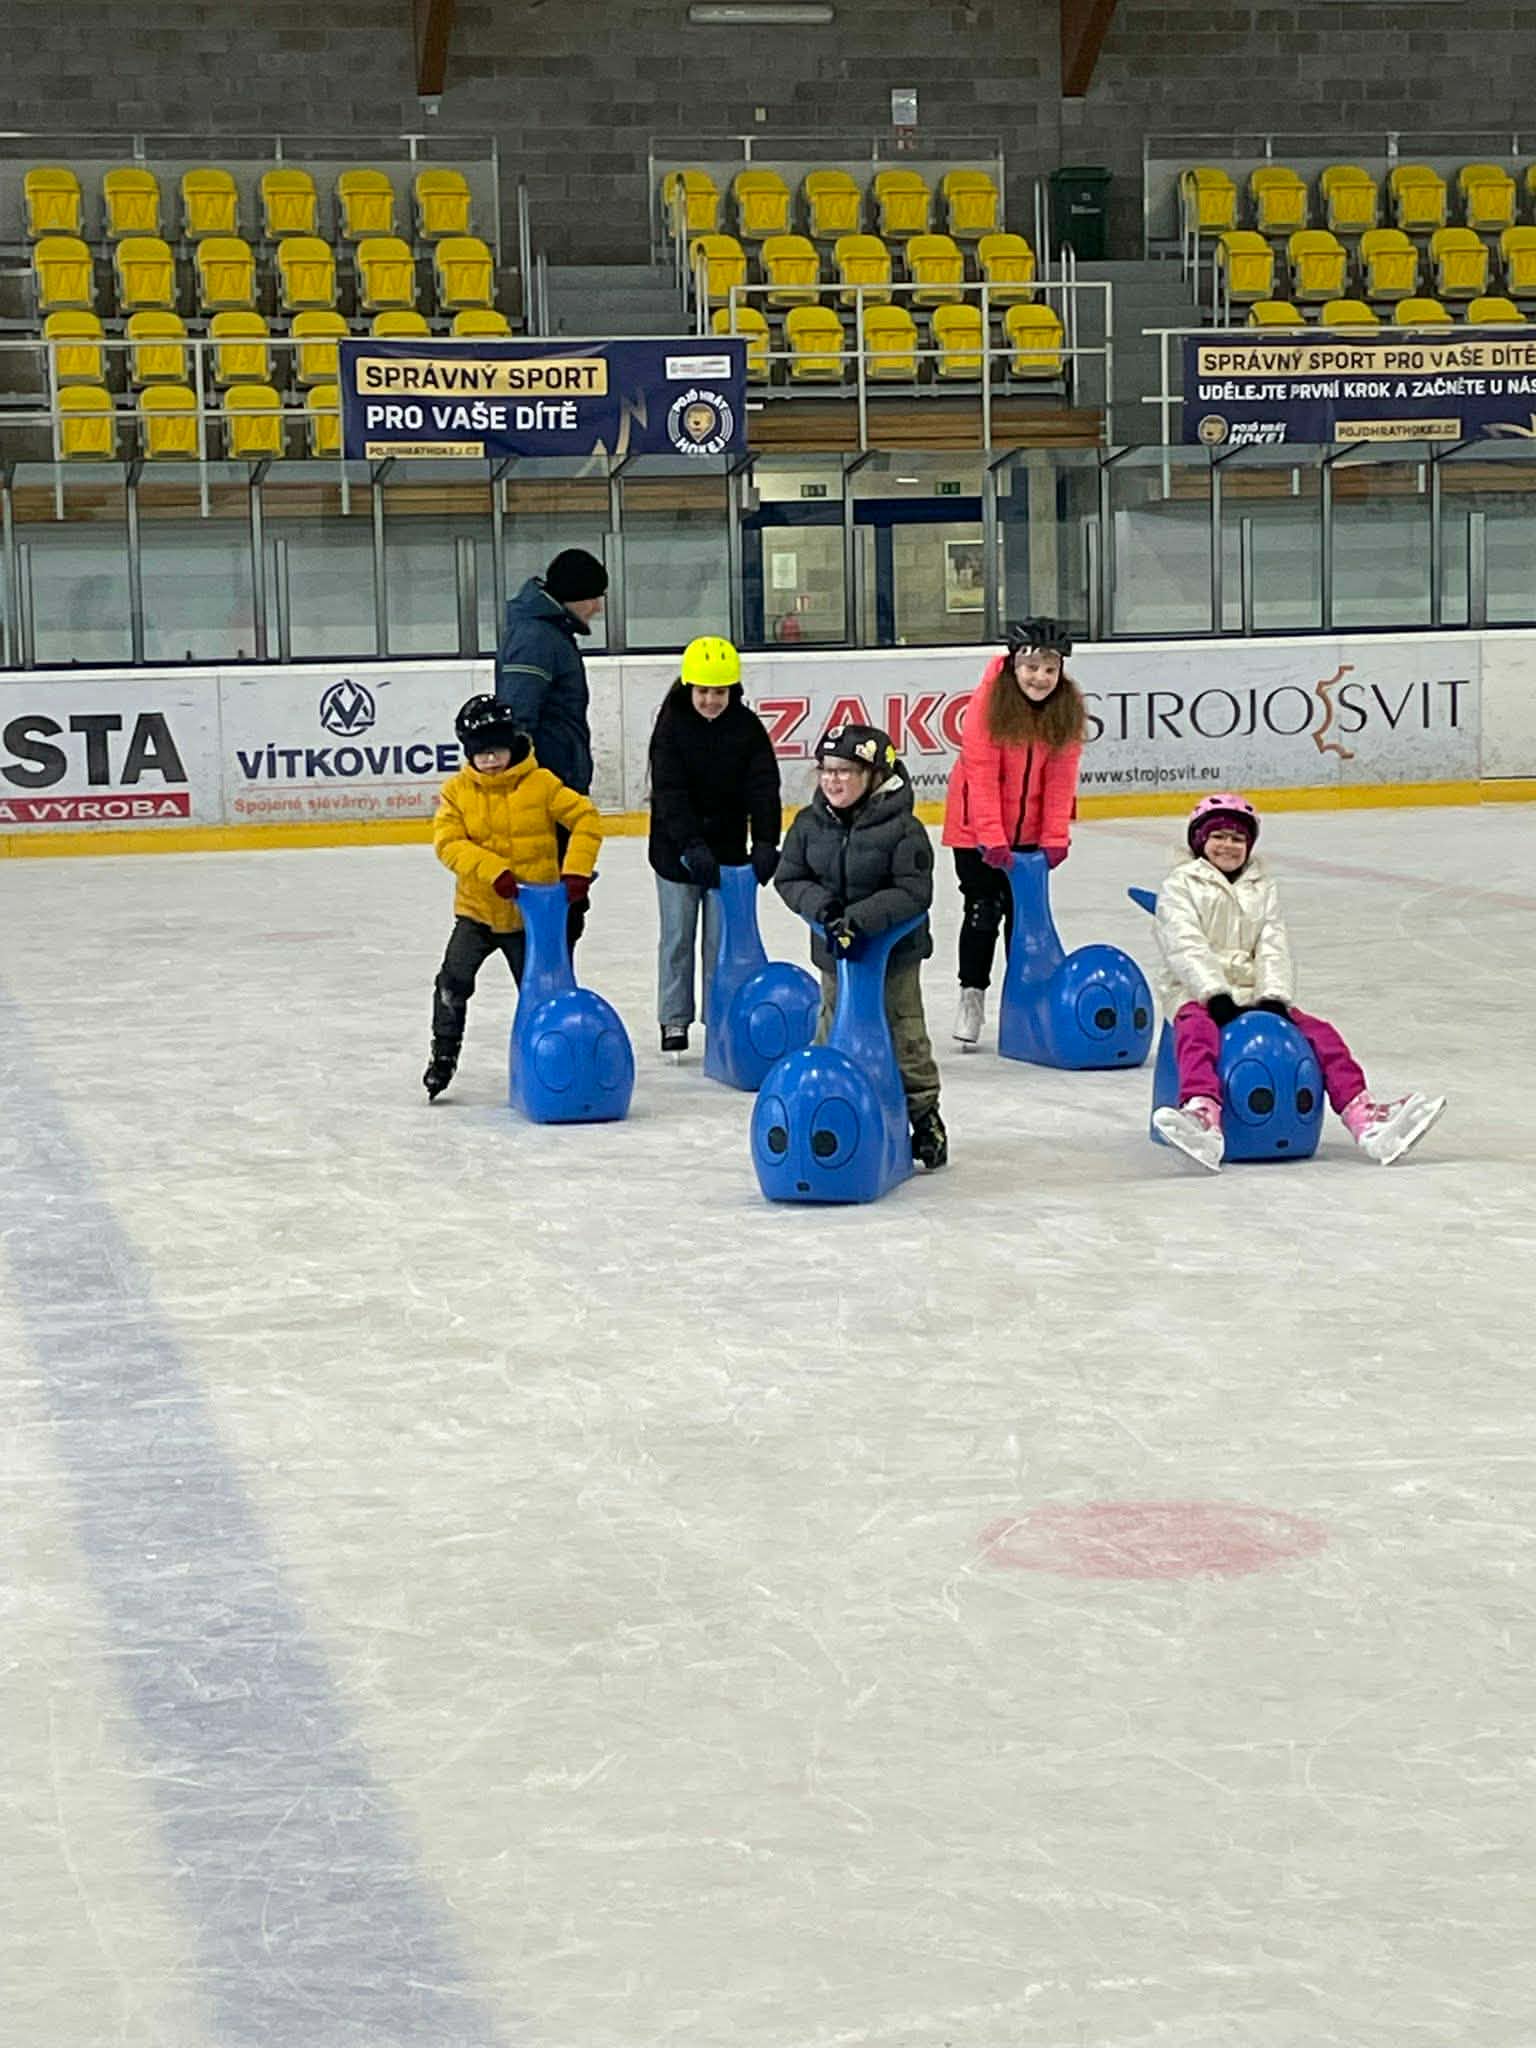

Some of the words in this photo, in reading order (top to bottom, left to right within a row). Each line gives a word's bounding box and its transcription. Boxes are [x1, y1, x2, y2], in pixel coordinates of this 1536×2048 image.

[1204, 349, 1303, 371] SPRÁVNÝ
[1309, 352, 1376, 369] SPORT
[1384, 352, 1424, 369] PRO
[1430, 345, 1484, 367] VAŠE
[366, 363, 498, 389] SPRÁVNÝ
[508, 366, 599, 389] SPORT
[1199, 381, 1287, 400] UDĚLEJTE
[1290, 379, 1340, 399] PRVNÍ
[1344, 382, 1391, 398] KROK
[1395, 382, 1408, 398] A
[1412, 376, 1486, 398] ZAČNĚTE
[1490, 379, 1503, 395] U
[367, 405, 424, 429] PRO
[432, 401, 507, 429] VAŠE
[516, 401, 577, 430] DÍTĚ
[1083, 680, 1470, 743] STROJOSVIT
[1, 712, 188, 789] STA
[236, 743, 460, 779] VÍTKOVICE
[1080, 764, 1220, 784] www.strojosvit.eu
[28, 799, 182, 820] VÝROBA
[234, 796, 302, 814] Spojené
